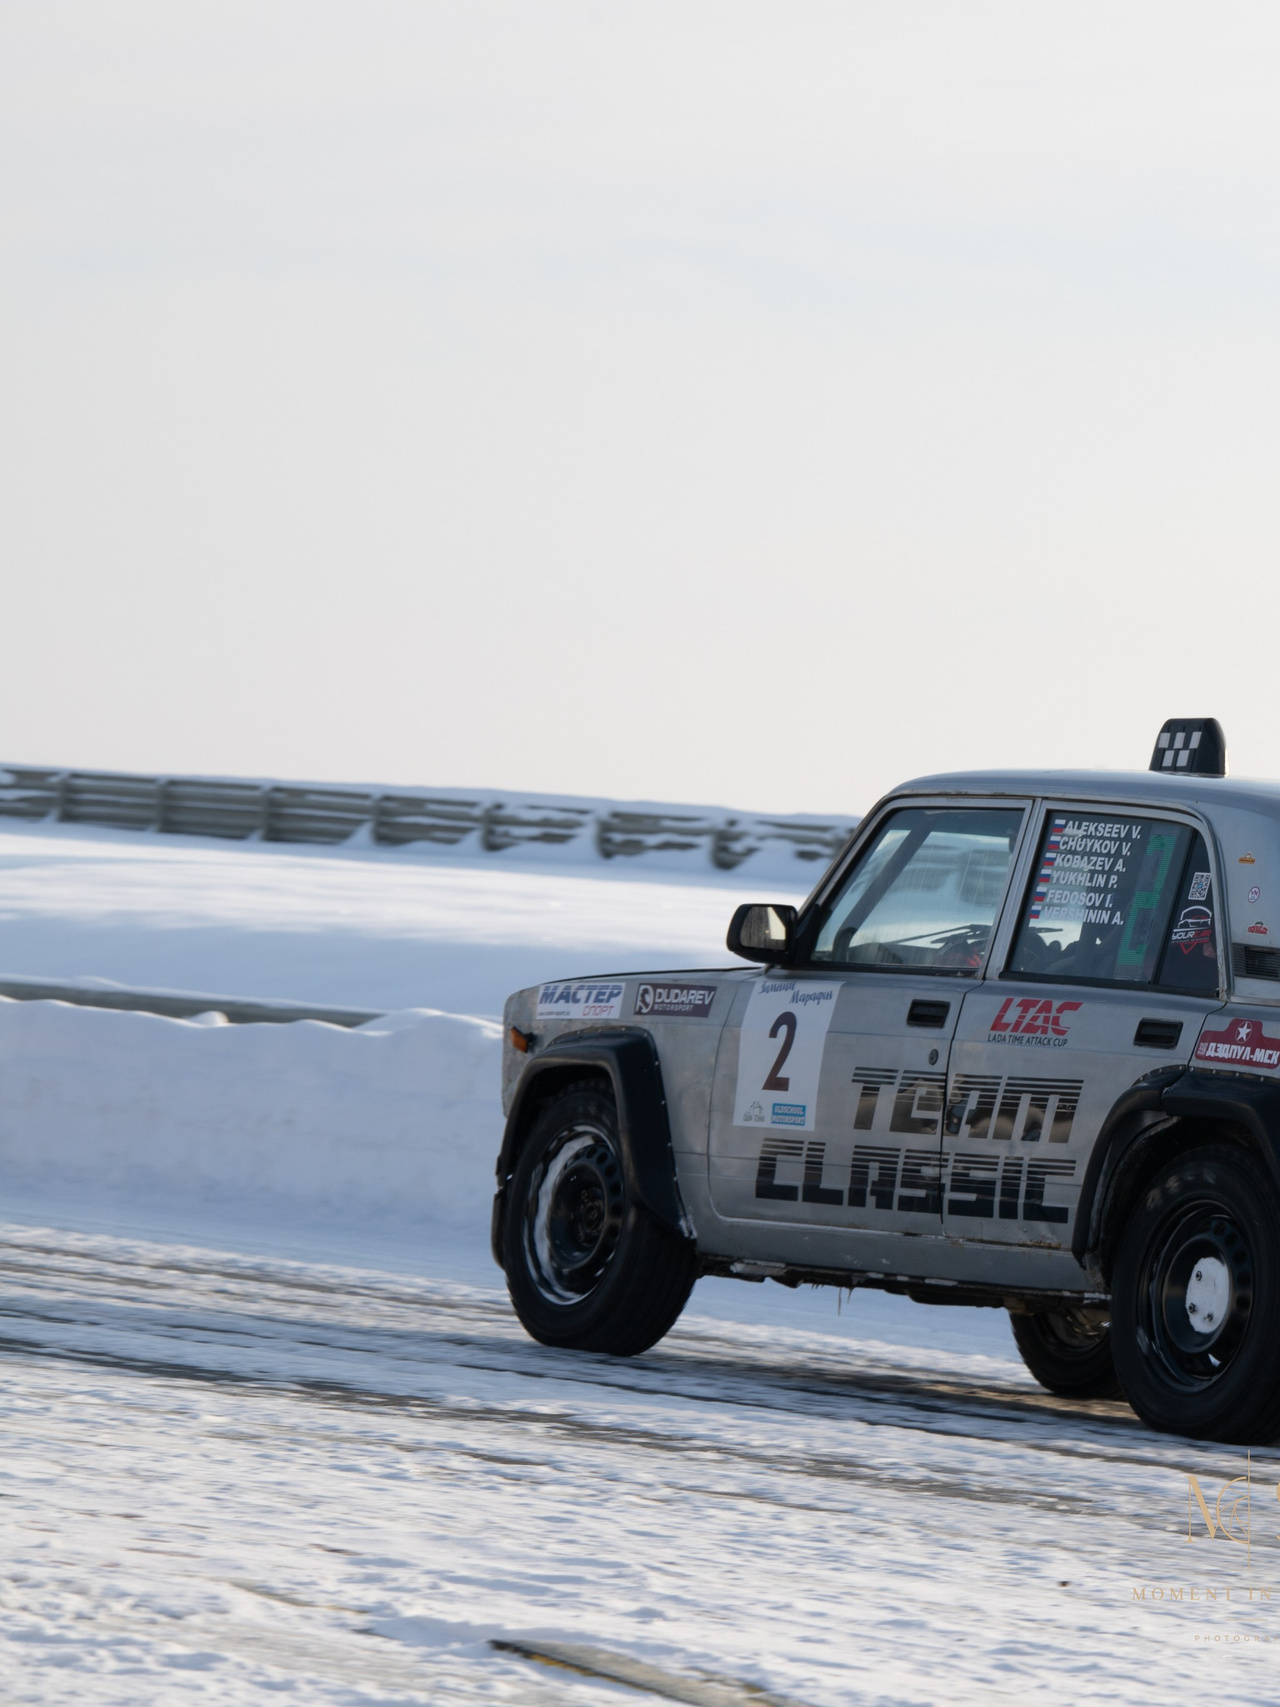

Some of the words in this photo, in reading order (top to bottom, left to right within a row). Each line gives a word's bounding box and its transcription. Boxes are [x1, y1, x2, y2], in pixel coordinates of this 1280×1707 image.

[1063, 820, 1129, 839] ALEKSEEV
[1132, 826, 1142, 839] V.
[1059, 836, 1119, 855] CHUYKOV
[1122, 842, 1132, 856] V.
[1054, 853, 1113, 871] KOBAZEV
[1114, 858, 1126, 872] A.
[1052, 870, 1107, 888] YUKHLIN
[1108, 875, 1118, 889] P.
[1046, 889, 1105, 908] FEDOSOV
[1105, 894, 1113, 908] I.
[1044, 906, 1111, 923] VERSHININ
[1111, 911, 1124, 926] A.
[539, 985, 622, 1004] МАСТЕР
[655, 988, 714, 1005] DUDAREV
[582, 1005, 615, 1016] СПОРТ
[990, 997, 1084, 1036] LTAC
[987, 1033, 1006, 1043] LADA
[1008, 1034, 1024, 1044] TIME
[1025, 1036, 1052, 1046] ATTACK
[1053, 1038, 1068, 1047] CUP
[762, 1011, 797, 1092] 2
